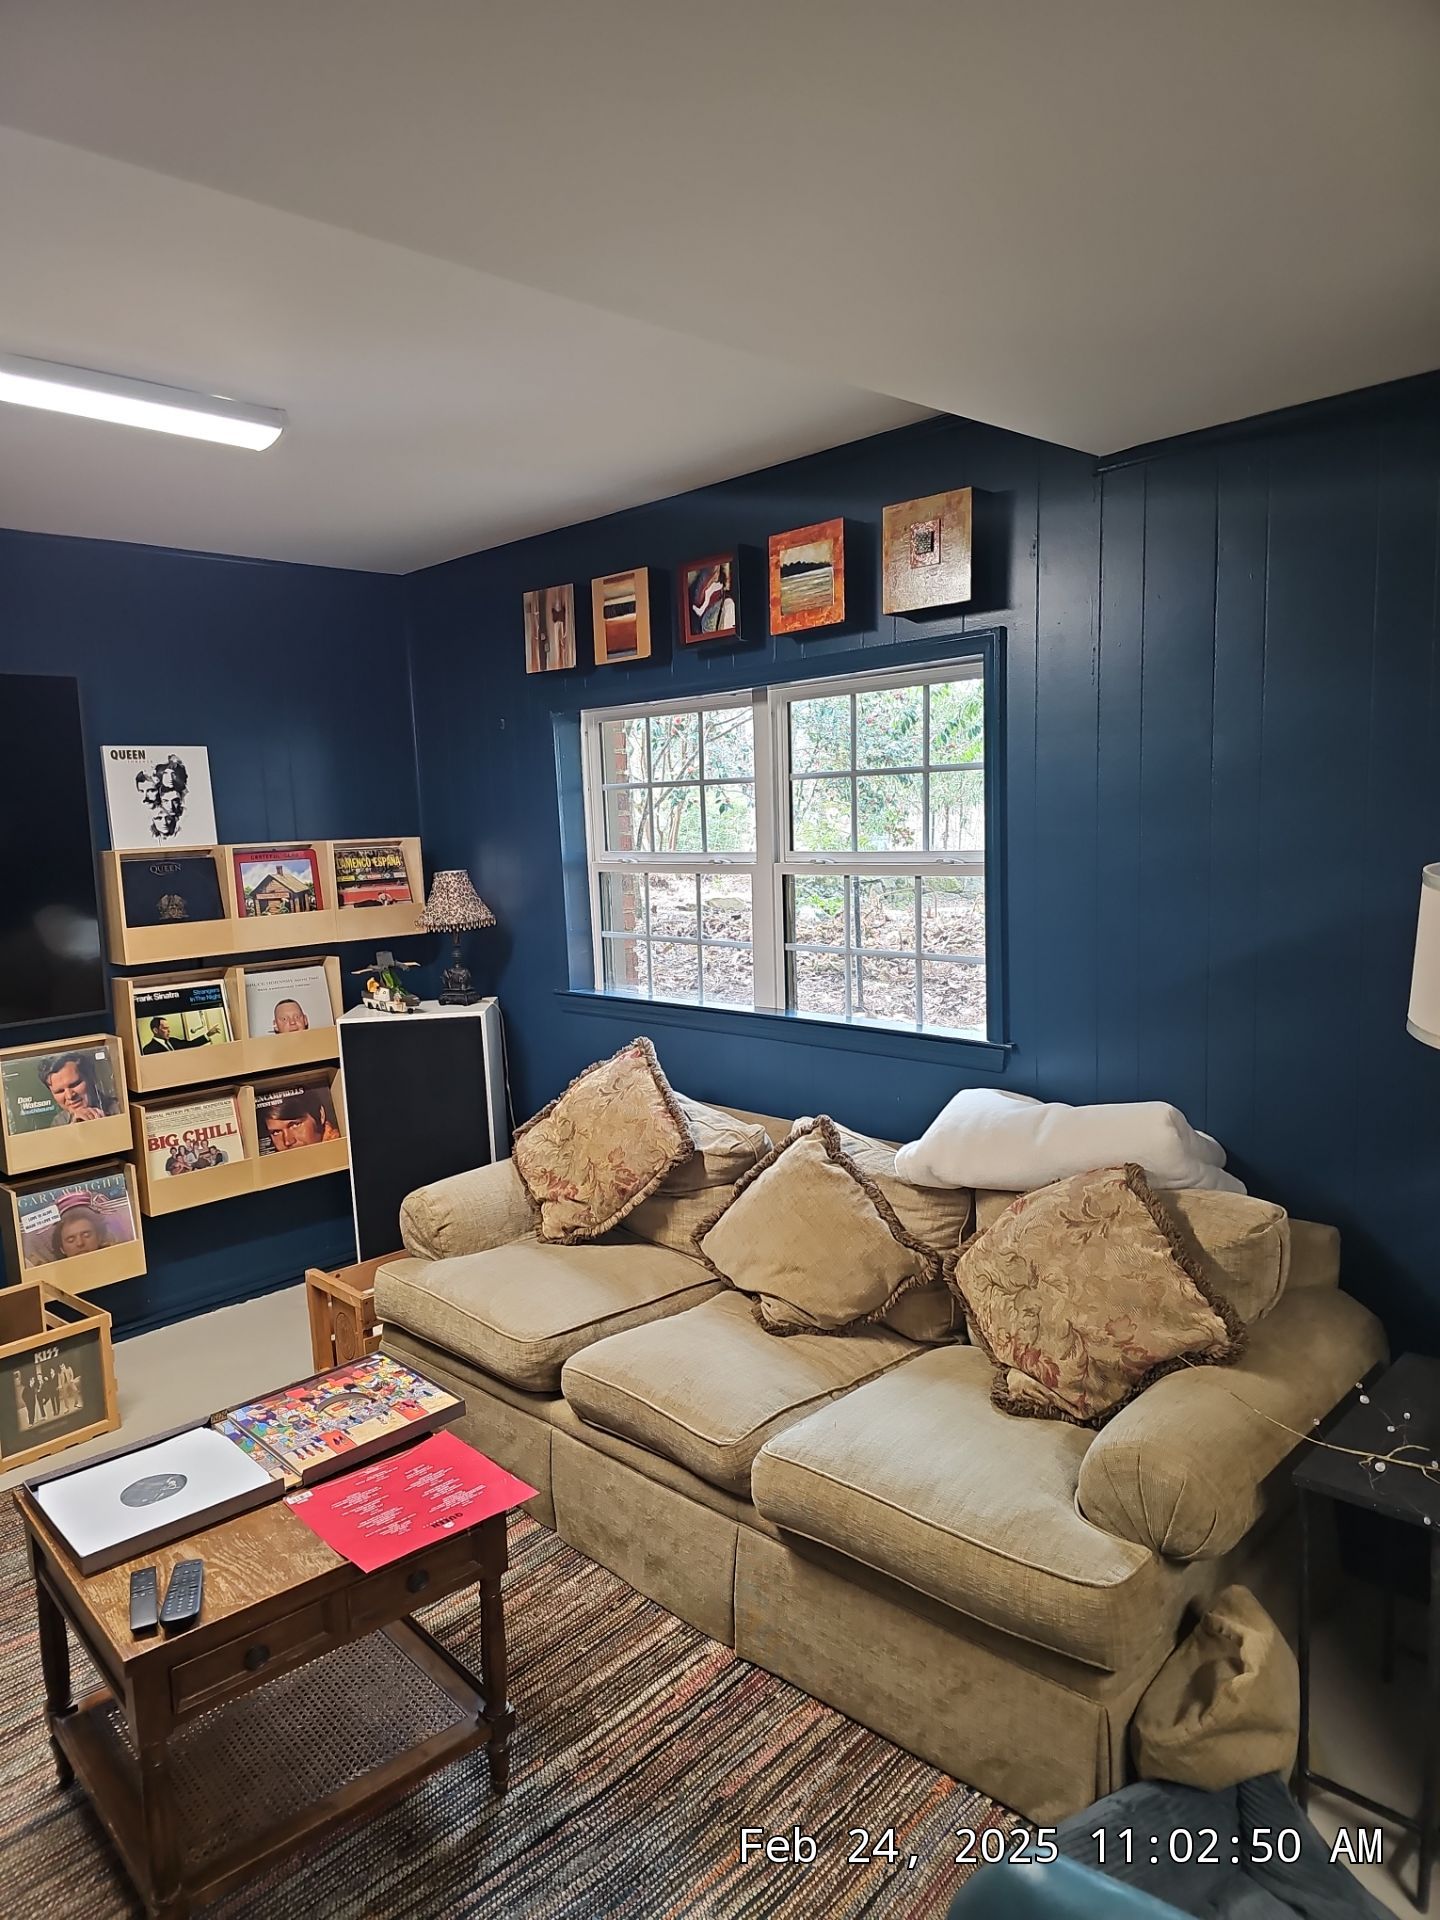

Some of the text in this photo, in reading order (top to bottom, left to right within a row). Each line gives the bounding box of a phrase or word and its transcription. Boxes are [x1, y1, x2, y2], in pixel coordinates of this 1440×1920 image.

[110, 750, 146, 760] QUEEN
[149, 862, 182, 876] QUEEN
[153, 991, 180, 1001] Sinatra
[17, 1096, 33, 1104] Doc
[22, 1100, 51, 1110] Watson
[148, 1123, 237, 1152] BIG CHILL
[18, 1191, 57, 1208] GARY
[62, 1177, 121, 1197] WRIGHT
[34, 1346, 60, 1364] KISS
